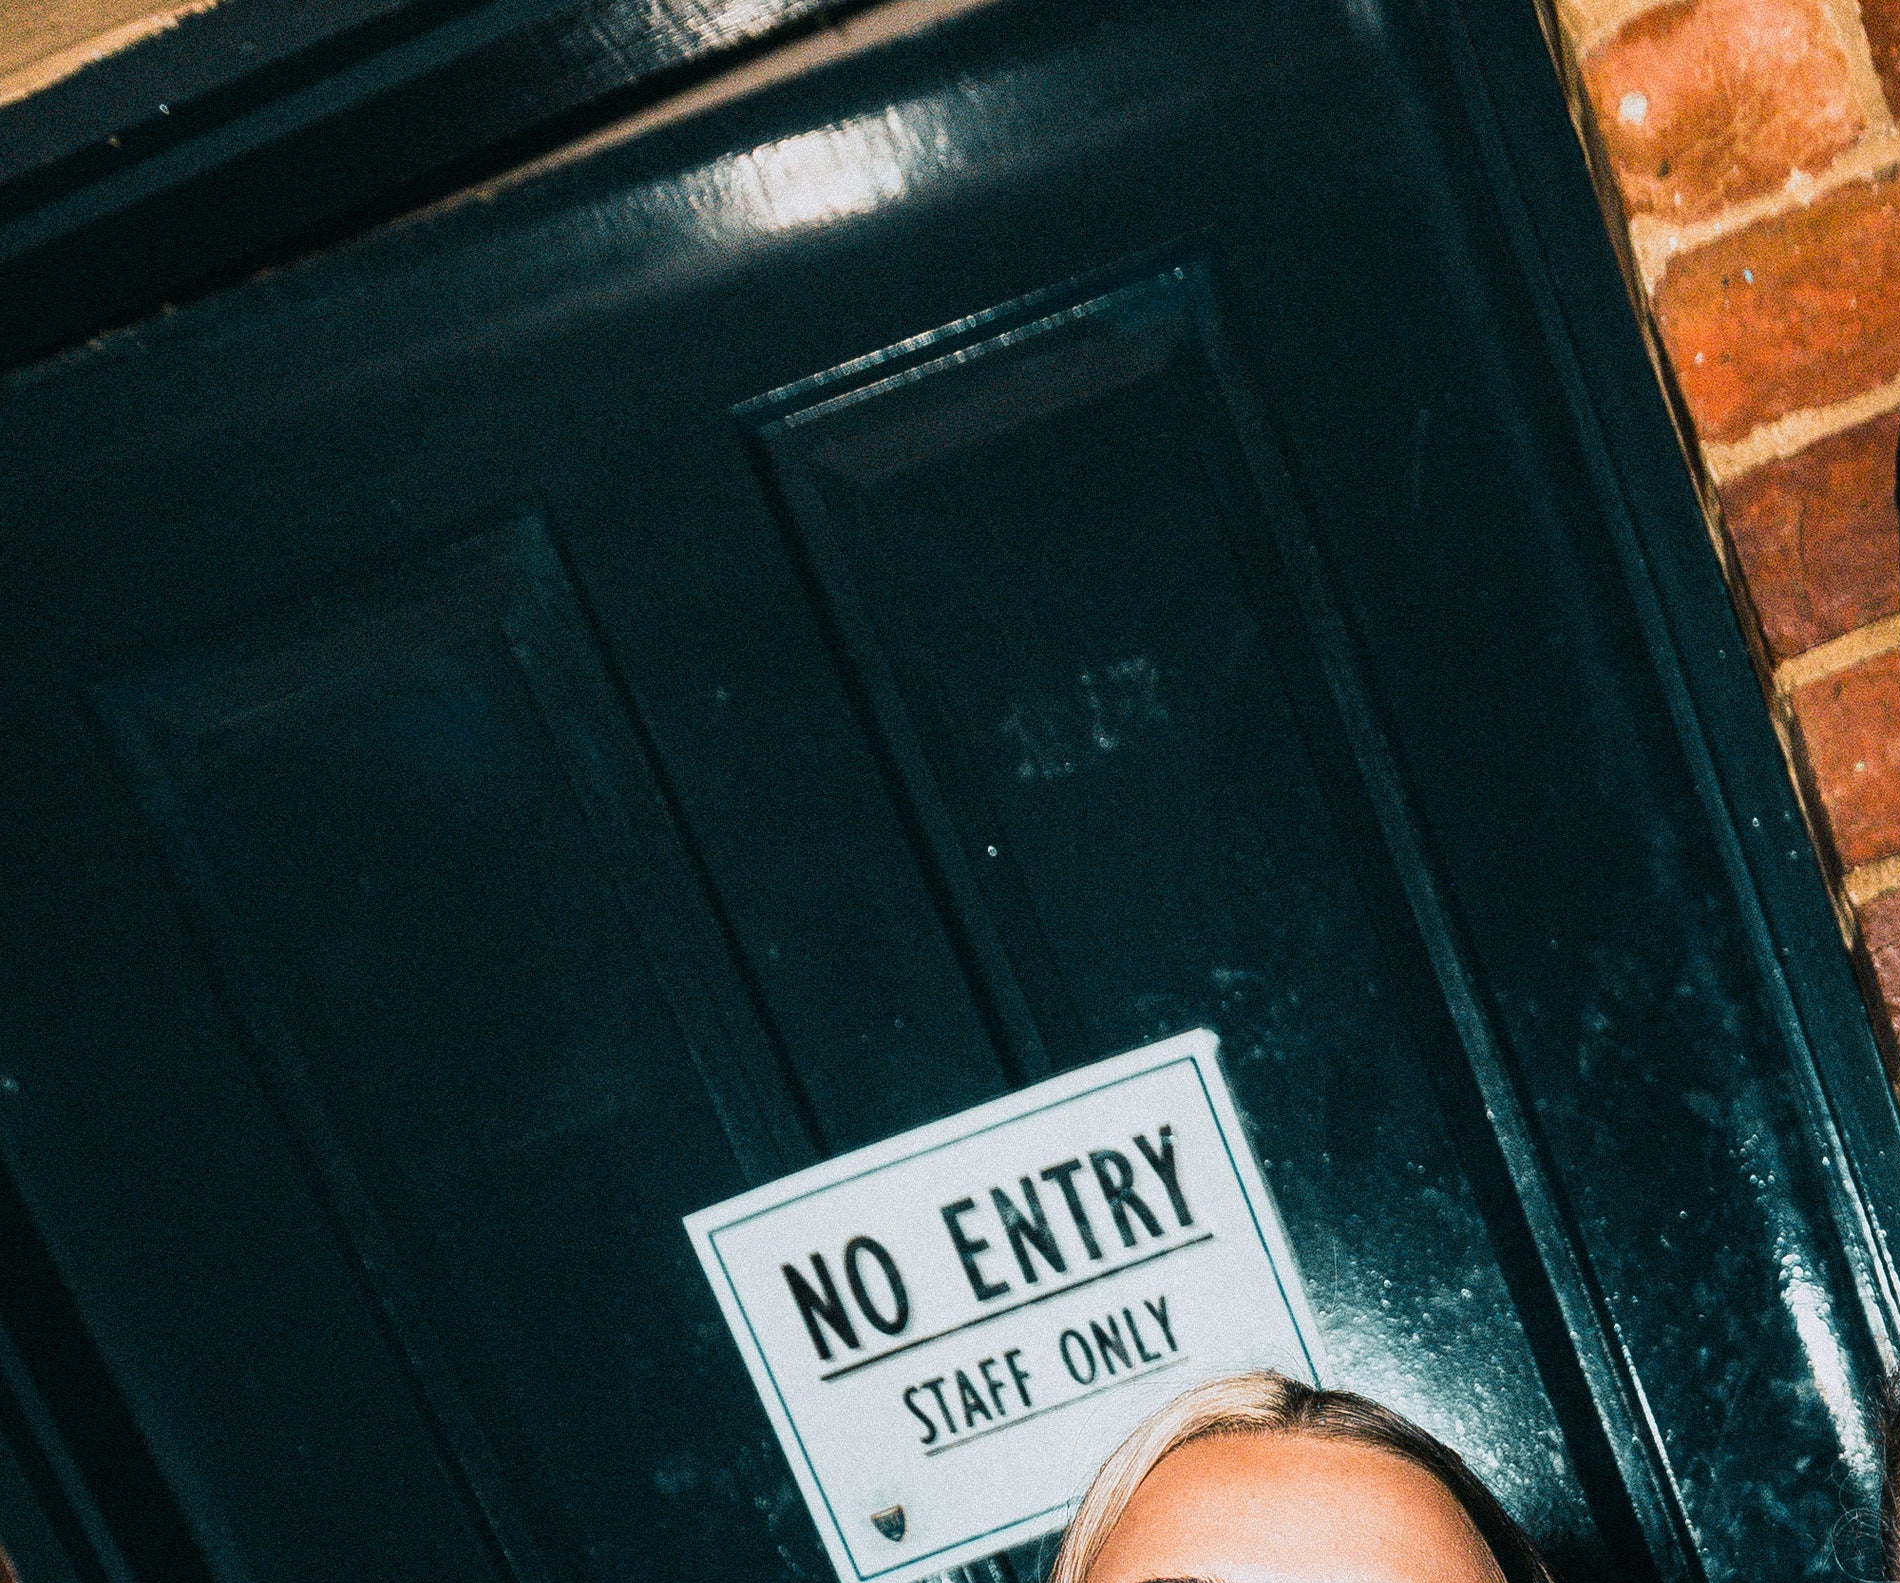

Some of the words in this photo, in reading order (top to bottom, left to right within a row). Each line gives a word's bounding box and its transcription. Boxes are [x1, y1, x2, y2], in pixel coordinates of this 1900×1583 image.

[780, 1235, 911, 1361] NO
[940, 1125, 1195, 1301] ENTRY
[903, 1349, 1034, 1445] STAFF
[1059, 1296, 1179, 1385] ONLY
